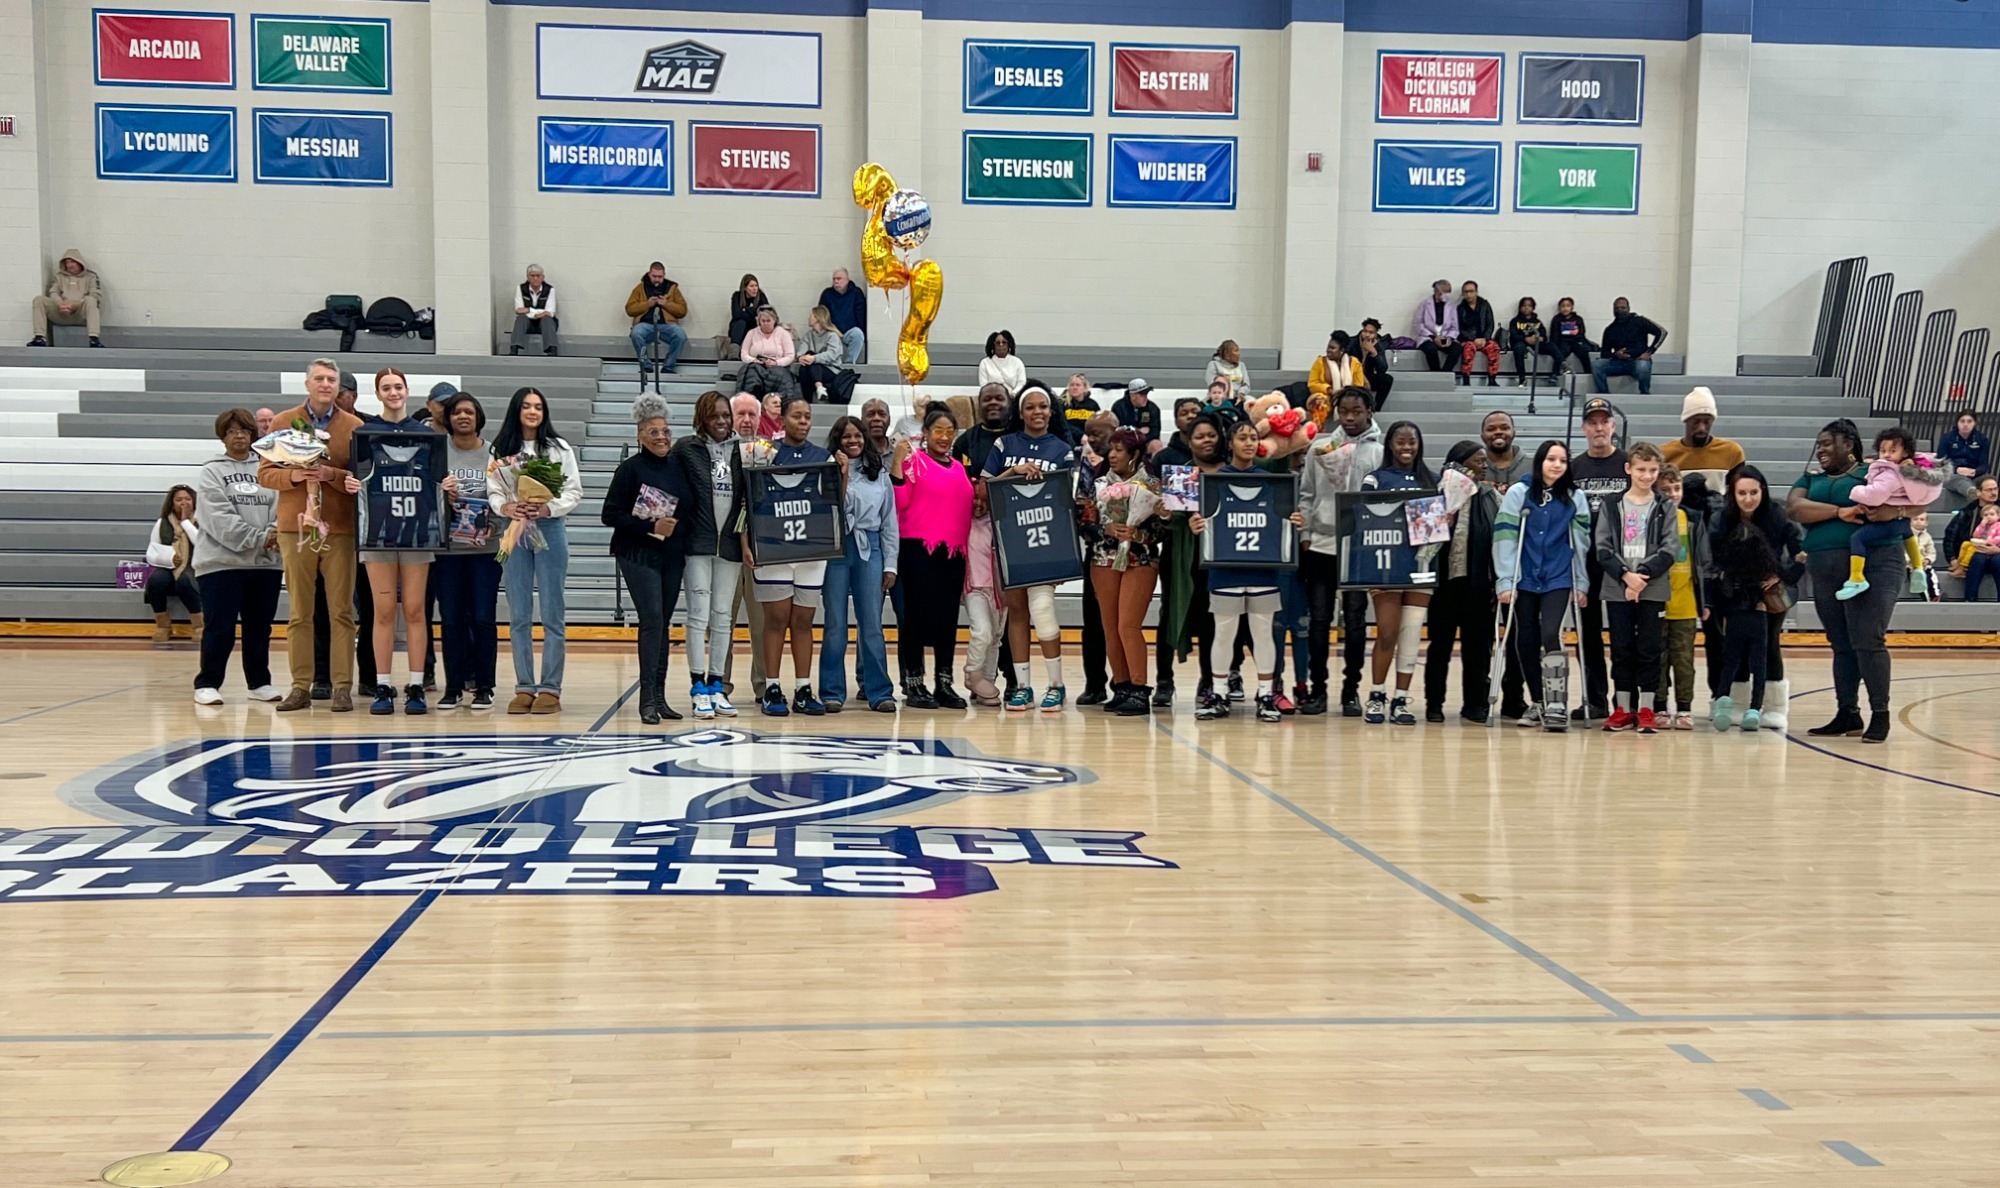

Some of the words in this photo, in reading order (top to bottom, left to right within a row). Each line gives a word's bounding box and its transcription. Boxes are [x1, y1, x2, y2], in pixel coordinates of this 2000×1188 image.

[128, 38, 201, 60] ARCADIA
[283, 35, 360, 54] DELAWARE
[295, 54, 349, 72] VALLEY
[1407, 61, 1475, 78] FAIRLEIGH
[642, 66, 715, 89] MAC
[994, 67, 1064, 87] DESALES
[1139, 71, 1209, 91] EASTERN
[1404, 79, 1476, 96] DICKINSON
[1561, 80, 1601, 99] HOOD
[1408, 97, 1470, 114] FLORHAM
[124, 132, 209, 152] LYCOMING
[286, 137, 359, 157] MESSIAH
[549, 145, 665, 167] MISERICORDIA
[720, 148, 791, 169] STEVENS
[982, 158, 1074, 179] STEVENSON
[1137, 162, 1207, 182] WIDENER
[1408, 167, 1466, 186] WILKES
[1558, 169, 1598, 187] YORK
[382, 476, 422, 492] HOOD
[391, 496, 416, 517] 50
[774, 500, 812, 517] HOOD
[1016, 506, 1054, 527] HOOD
[784, 520, 807, 541] 32
[1227, 513, 1267, 528] HOOD
[1026, 526, 1050, 548] 25
[1235, 531, 1260, 551] 22
[1363, 530, 1402, 546] HOOD
[1375, 549, 1391, 569] 11
[124, 571, 143, 580] GIVE
[302, 823, 1171, 868] COLLEGE
